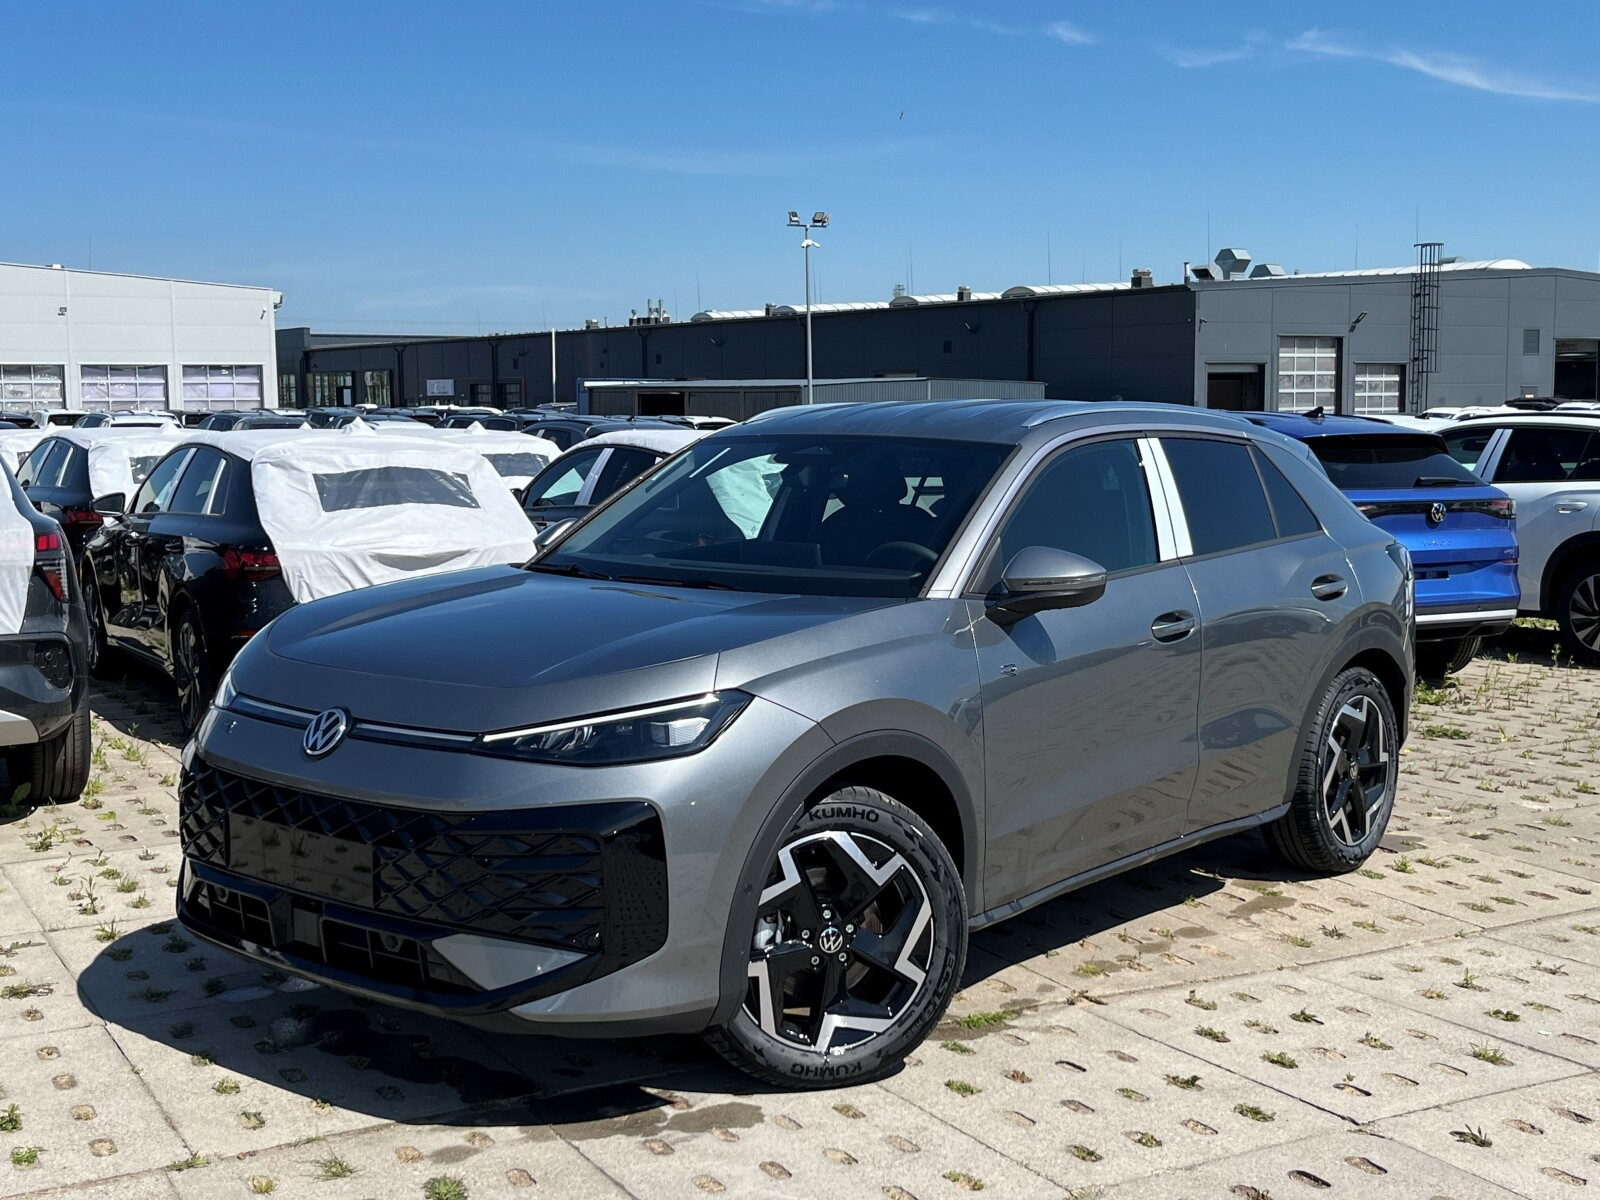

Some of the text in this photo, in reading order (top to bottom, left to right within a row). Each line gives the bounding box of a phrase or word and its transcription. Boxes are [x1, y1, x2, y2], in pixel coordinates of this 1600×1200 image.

[303, 708, 347, 755] VW
[1321, 700, 1342, 746] KUMHO
[808, 805, 880, 823] KUMHO
[819, 927, 843, 953] VW
[790, 1061, 862, 1078] KUMHO
